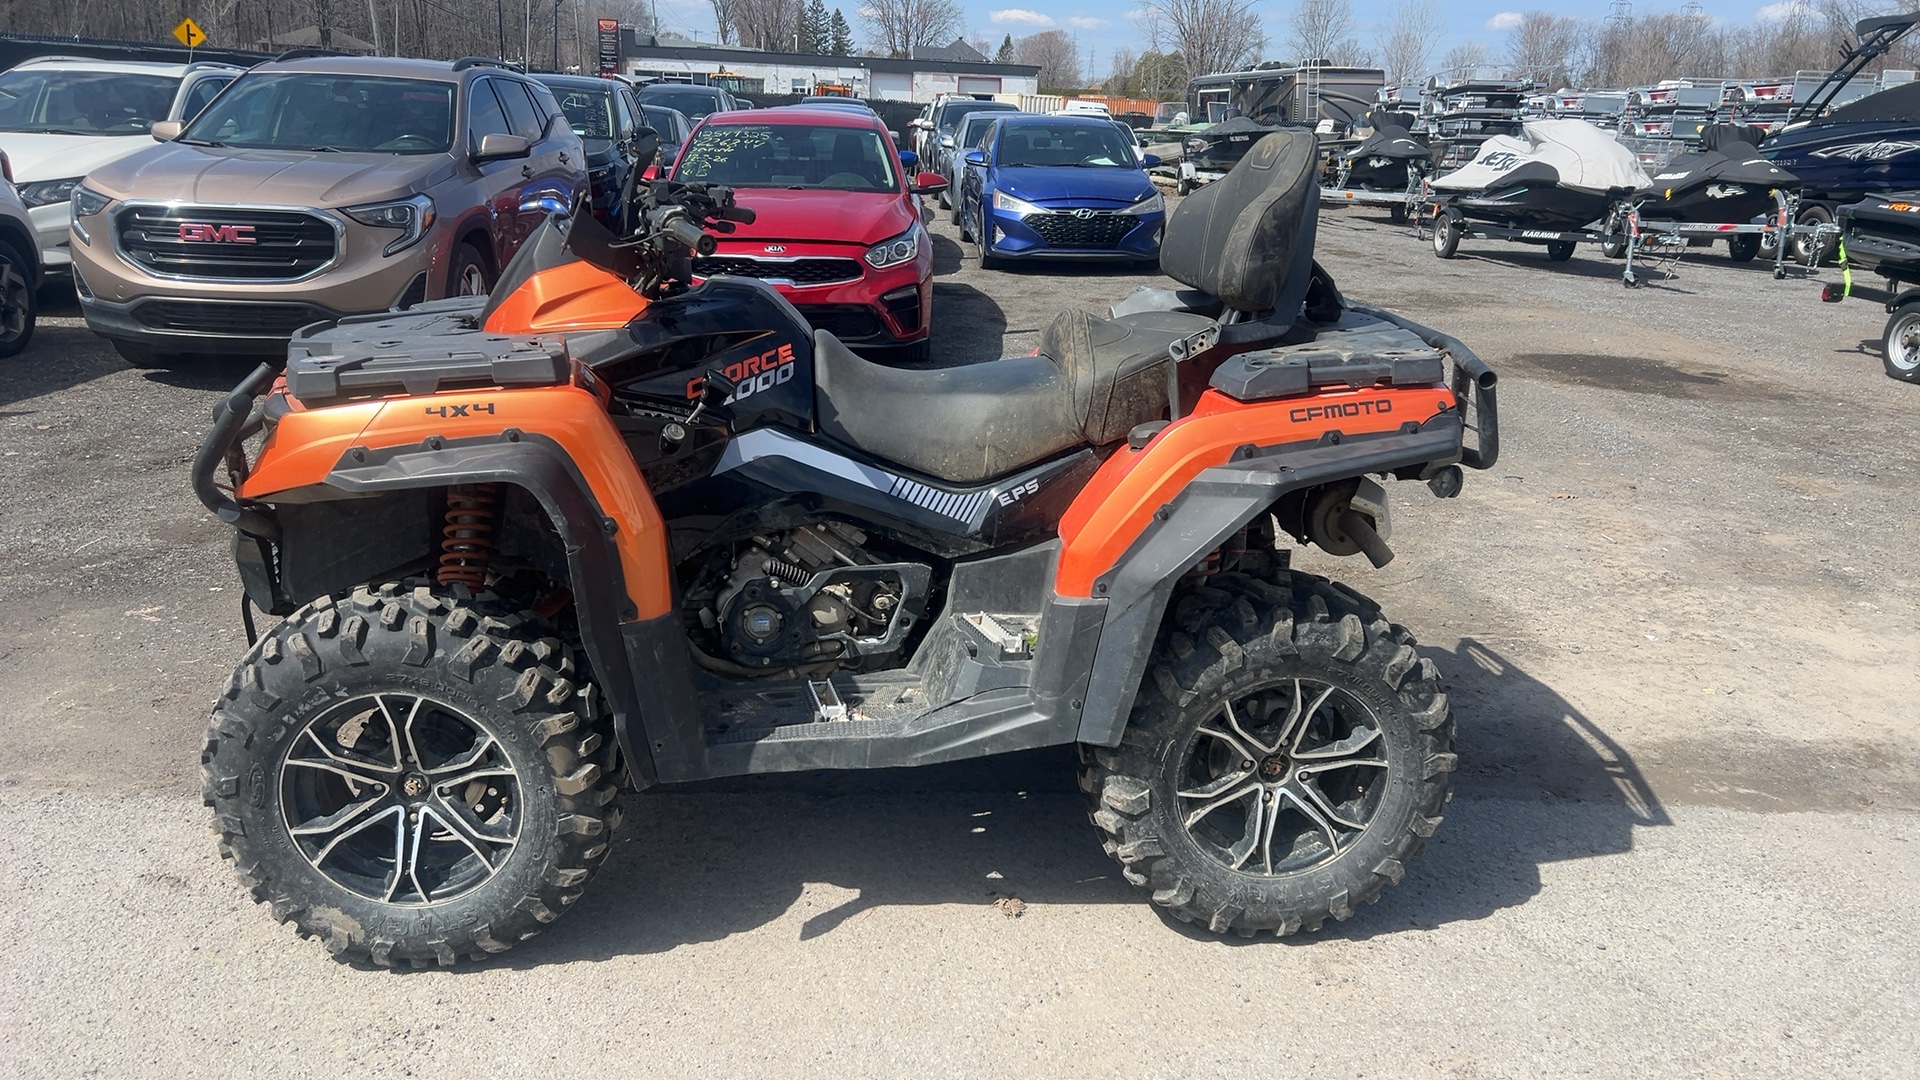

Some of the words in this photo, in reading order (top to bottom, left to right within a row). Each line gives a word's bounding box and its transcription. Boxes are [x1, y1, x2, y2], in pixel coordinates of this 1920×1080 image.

[179, 223, 257, 243] GMC
[1521, 230, 1561, 239] KARAVAN
[686, 343, 796, 399] CORCE
[425, 402, 495, 418] 4X4
[1289, 399, 1392, 423] CFMOTO
[998, 478, 1040, 507] EPS
